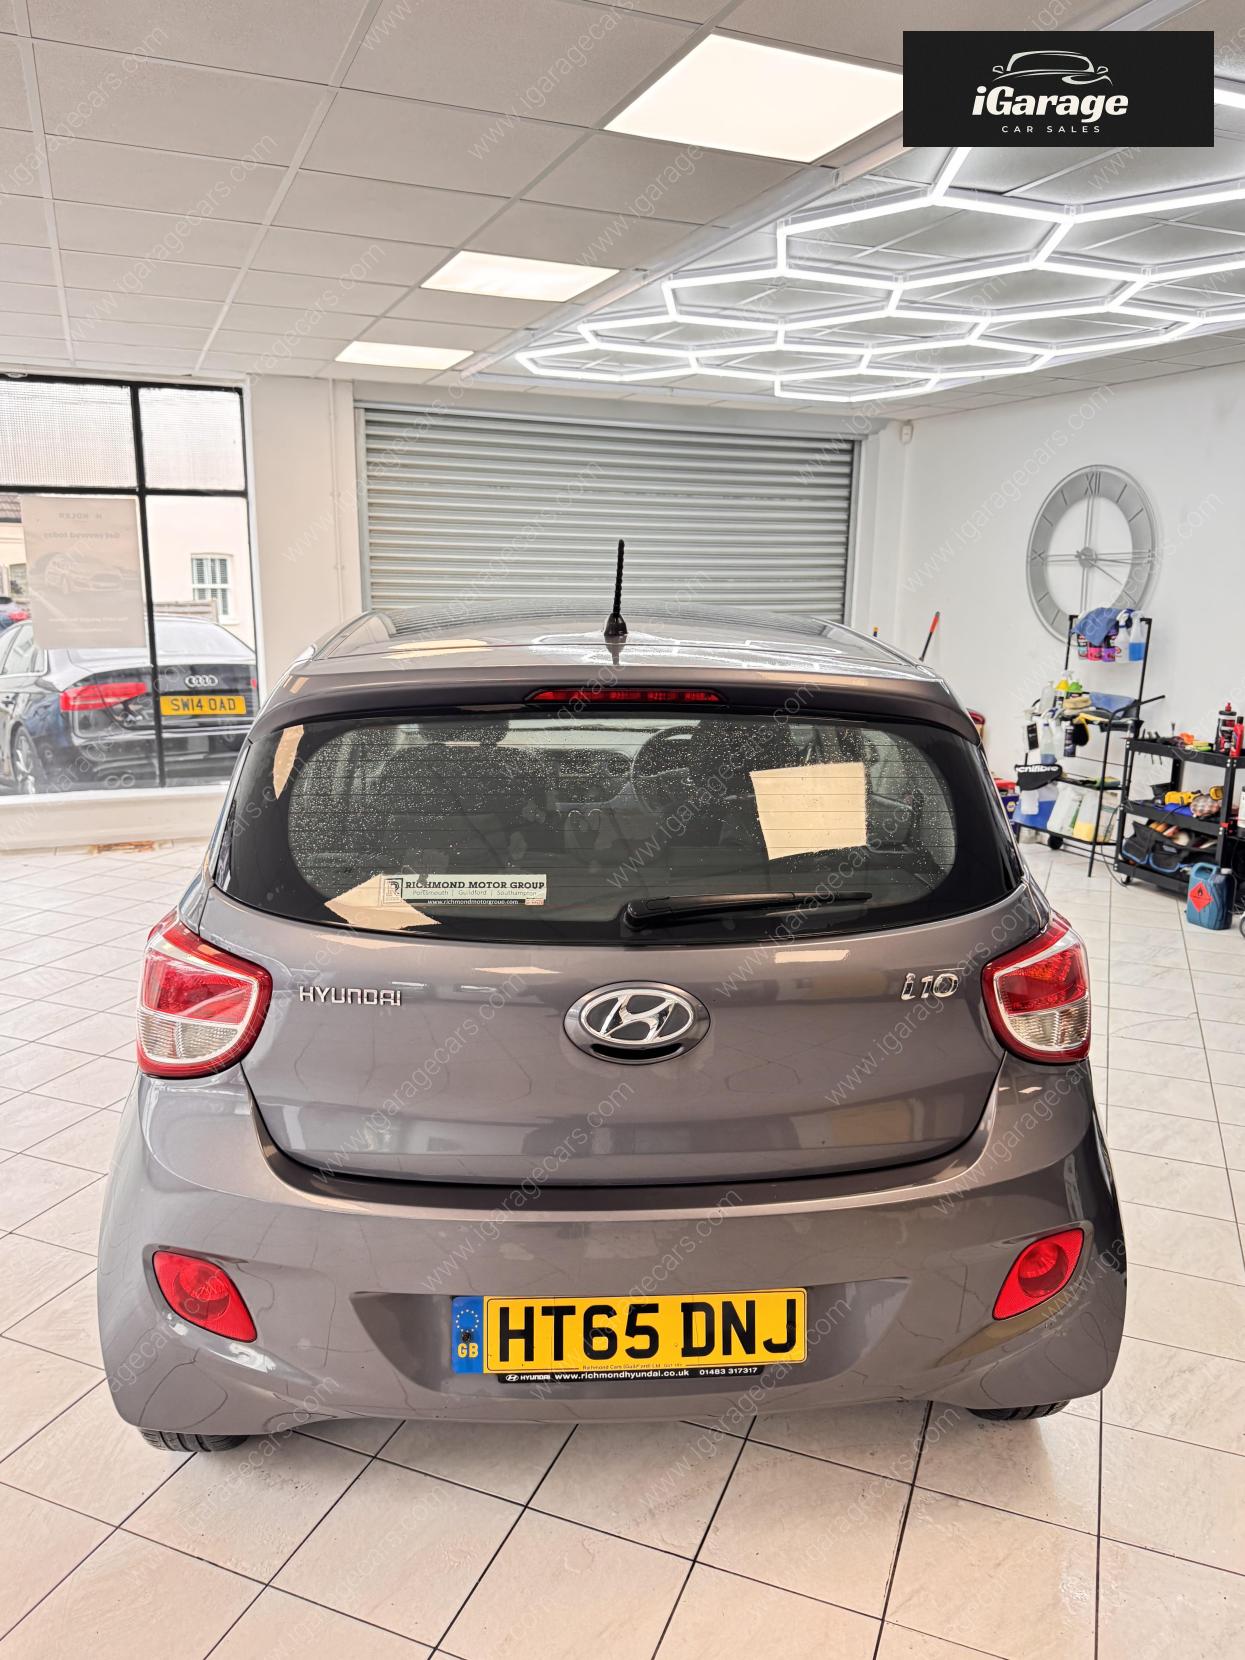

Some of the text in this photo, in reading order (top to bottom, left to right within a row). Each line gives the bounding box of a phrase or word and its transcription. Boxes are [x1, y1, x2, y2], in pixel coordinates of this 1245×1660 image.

[171, 697, 236, 712] SW14 OAD
[405, 881, 545, 889] RICHMOND MOTOR GROUP
[497, 889, 538, 897] Southampton
[427, 898, 519, 906] www.richmondmotorgroup.com
[901, 973, 959, 1000] i10
[299, 985, 401, 1006] HYUNDAI
[500, 1299, 797, 1362] HT65 DNJ
[457, 1343, 479, 1358] GB
[555, 1369, 690, 1381] www.richmondhyundai.co.uk
[699, 1368, 726, 1376] 01483
[728, 1367, 758, 1375] 317317
